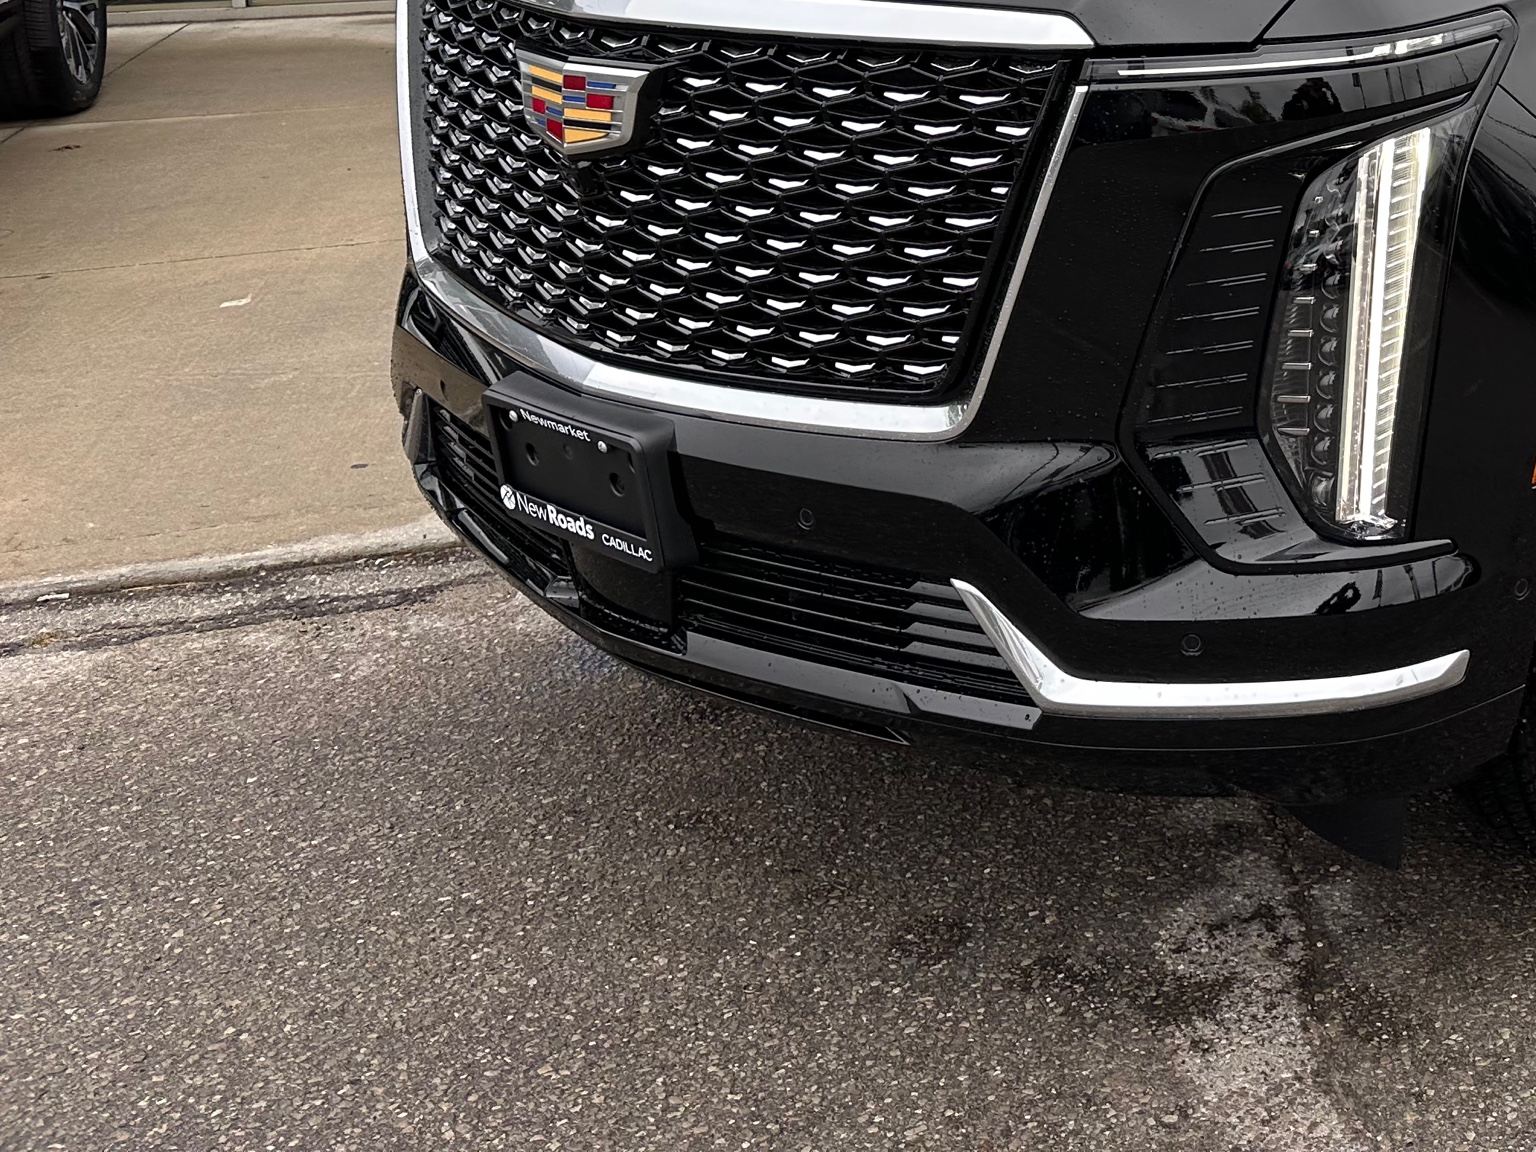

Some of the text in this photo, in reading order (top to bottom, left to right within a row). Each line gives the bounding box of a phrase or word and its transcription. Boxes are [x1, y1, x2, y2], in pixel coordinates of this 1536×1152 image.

[519, 408, 591, 442] Newmarket
[516, 492, 653, 562] NewRoads CADILLAC
